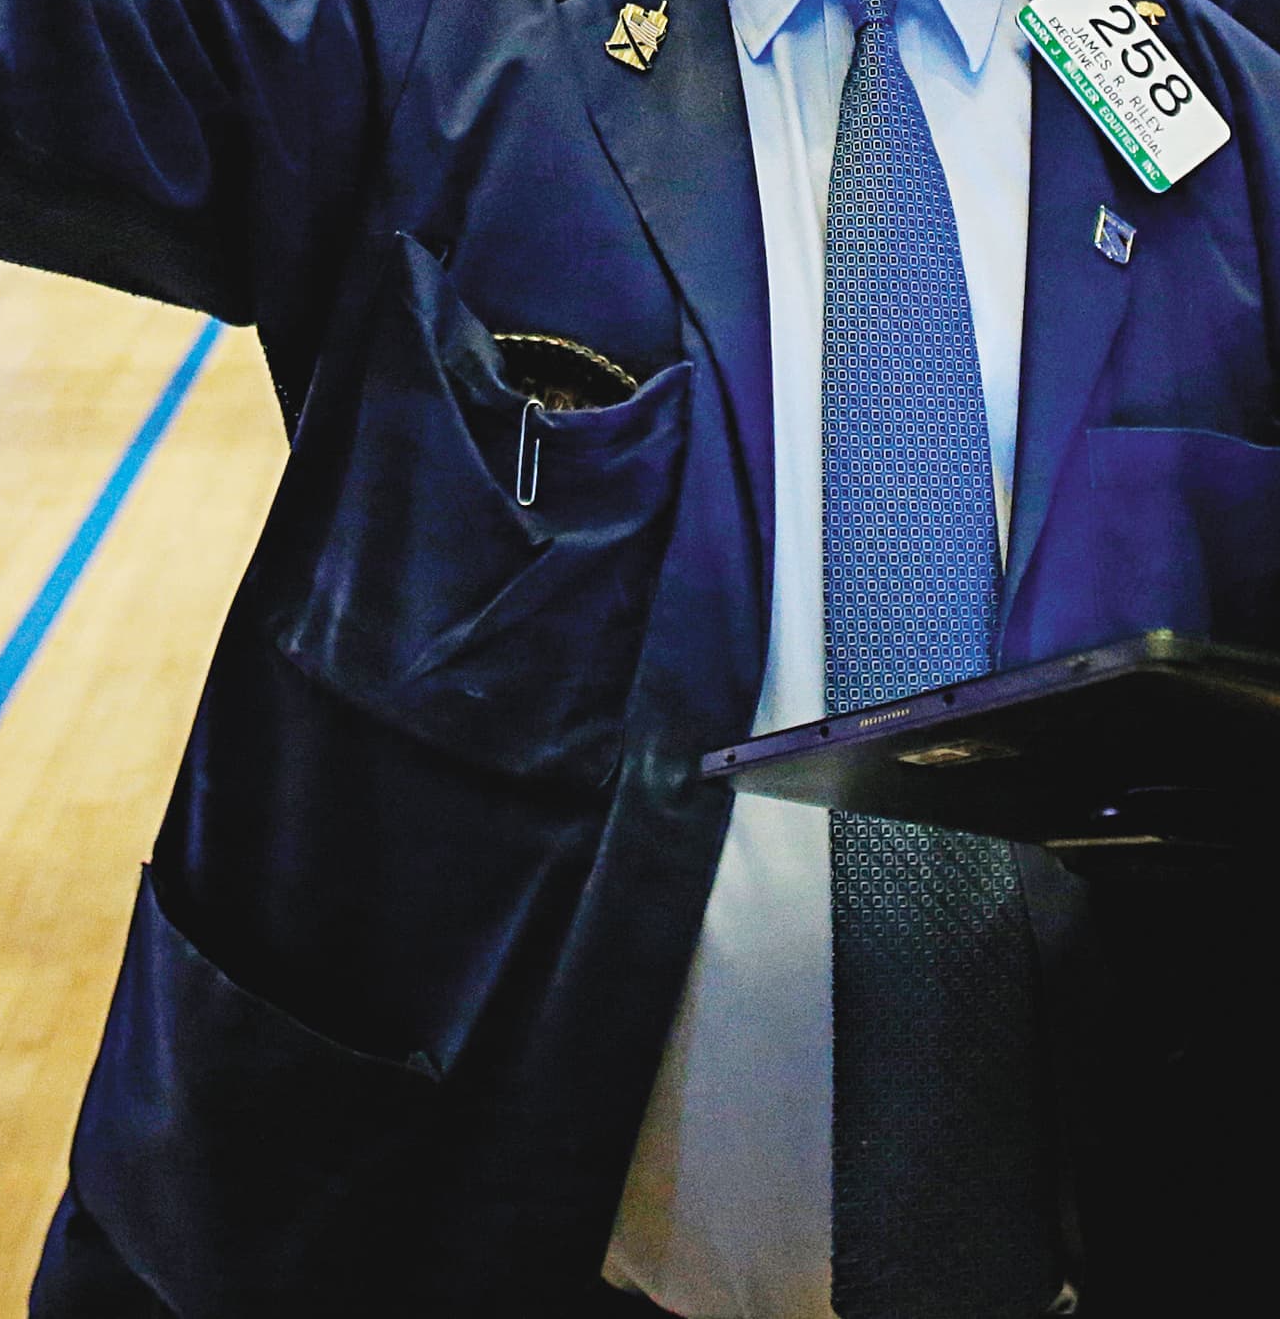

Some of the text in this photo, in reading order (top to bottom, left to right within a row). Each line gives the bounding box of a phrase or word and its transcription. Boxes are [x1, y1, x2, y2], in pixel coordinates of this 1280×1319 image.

[1024, 12, 1053, 45] MARK
[1062, 60, 1101, 105] MULLER
[1048, 16, 1163, 158] EXECUTIVE FLOOR OFFICIAL
[1071, 26, 1113, 72] JAMES
[1129, 95, 1166, 134] RILEY
[1088, 4, 1195, 118] 258
